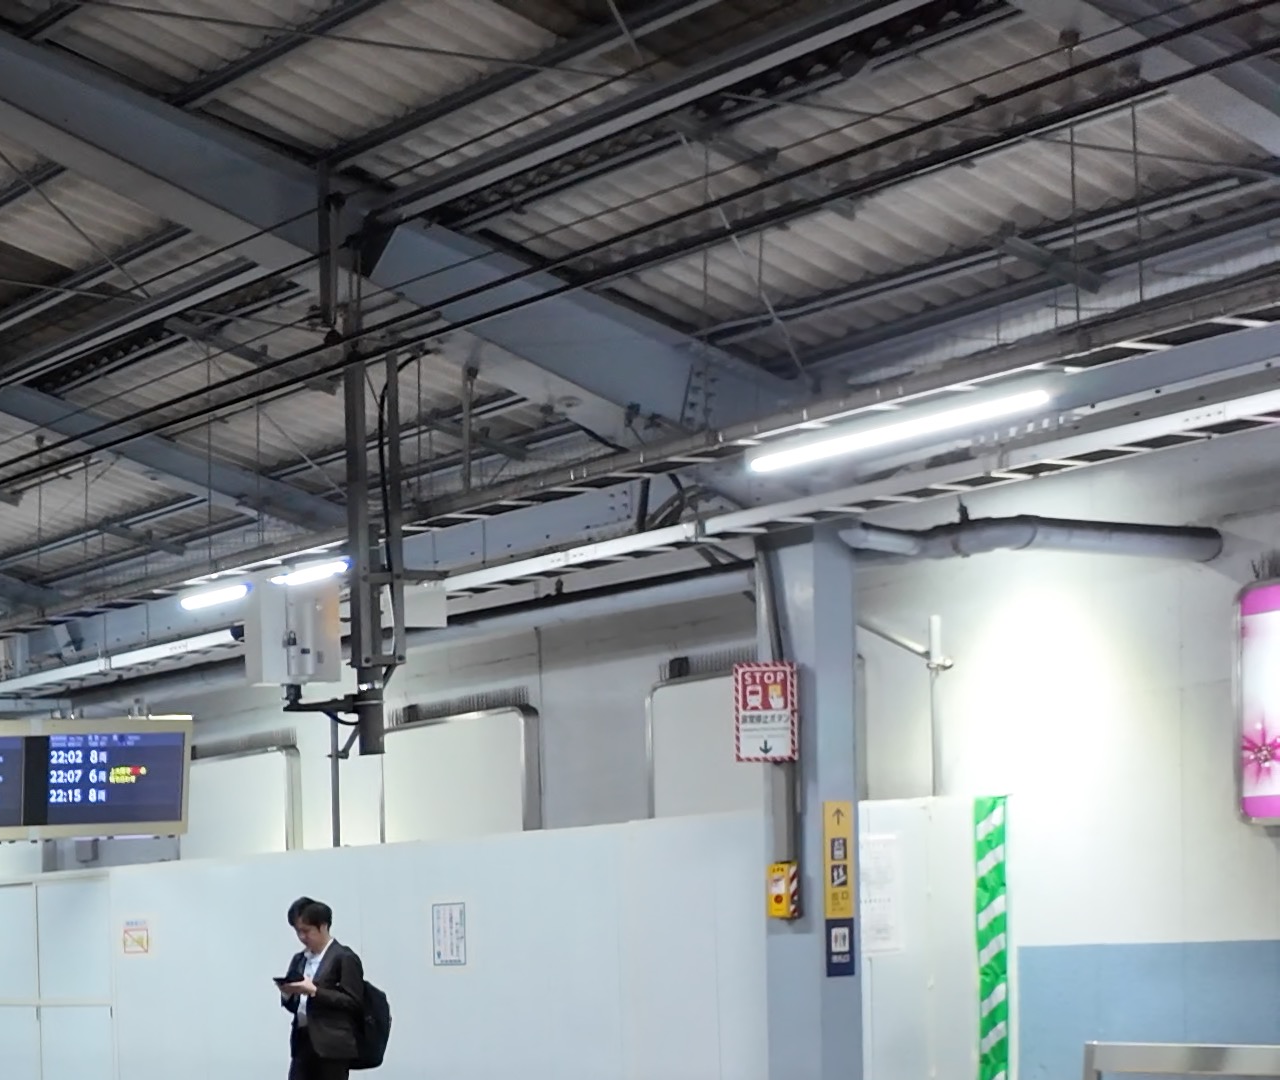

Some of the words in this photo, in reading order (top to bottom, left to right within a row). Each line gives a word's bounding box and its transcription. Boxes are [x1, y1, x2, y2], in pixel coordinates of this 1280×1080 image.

[744, 671, 785, 685] STOP
[741, 713, 790, 724] 非常停止ボタン
[50, 750, 83, 764] 22:02
[49, 769, 82, 784] 22:07
[49, 788, 82, 803] 22:15
